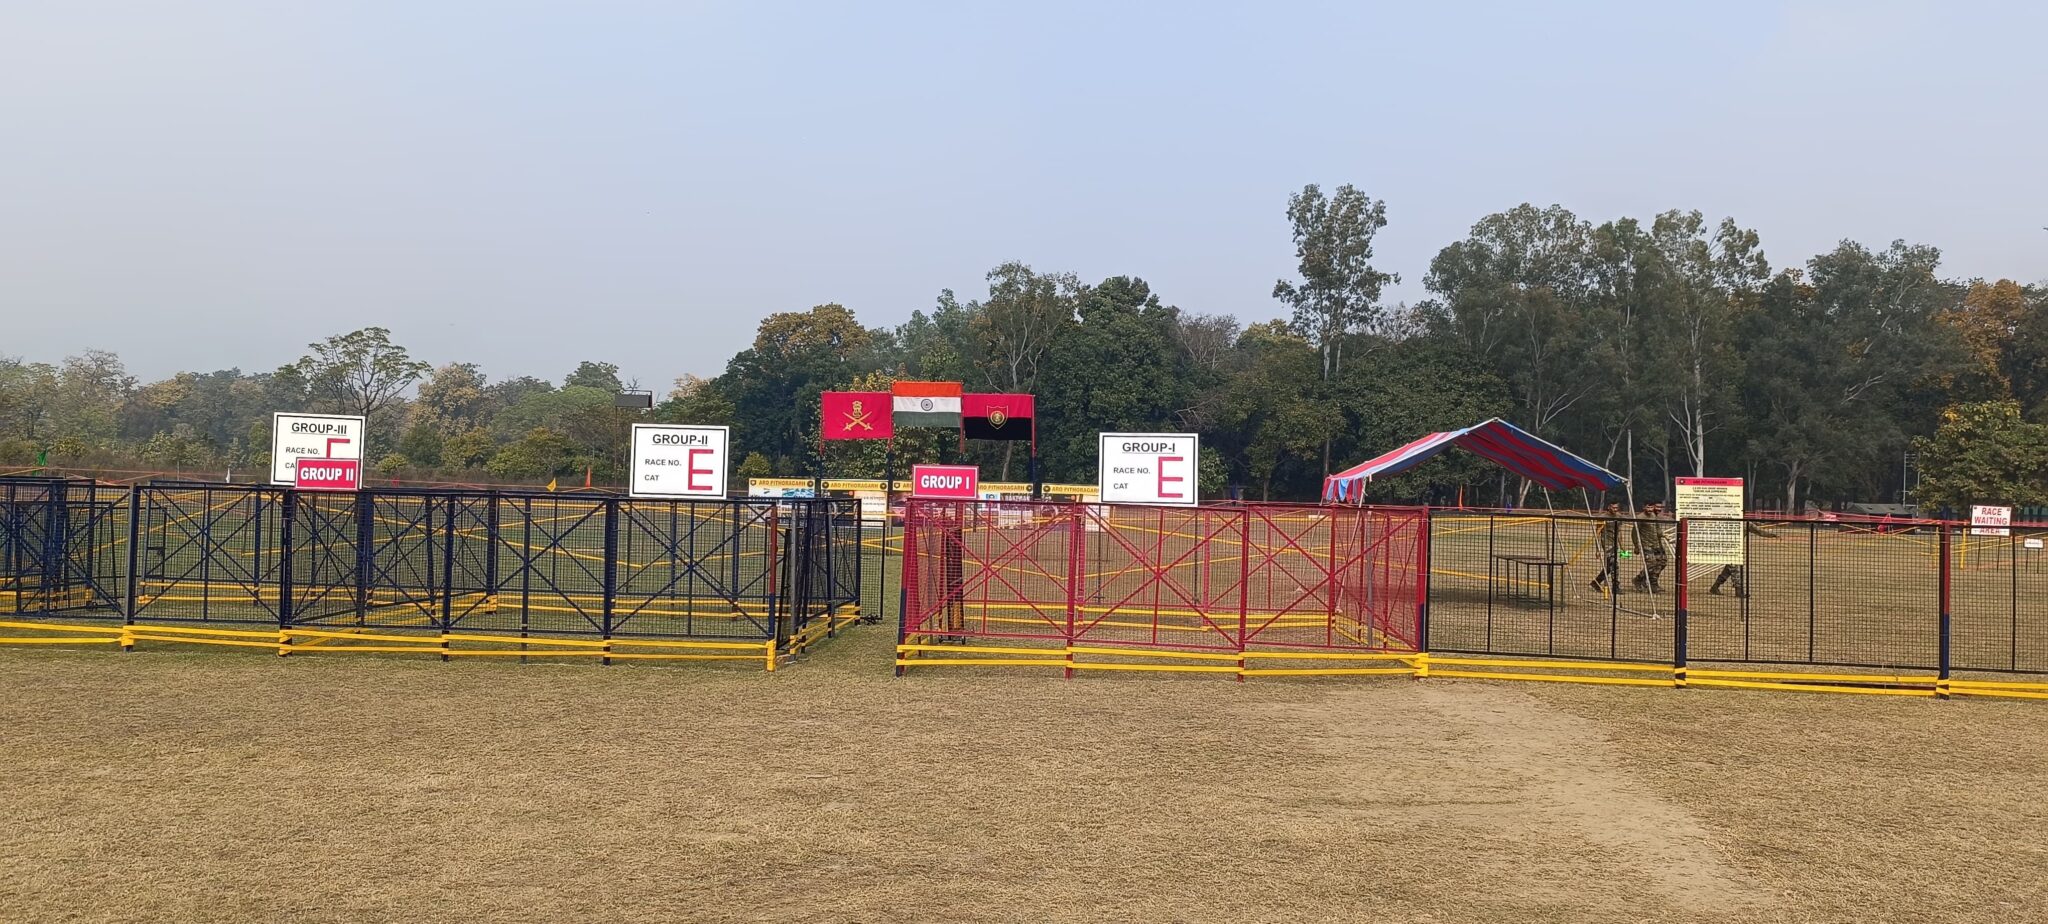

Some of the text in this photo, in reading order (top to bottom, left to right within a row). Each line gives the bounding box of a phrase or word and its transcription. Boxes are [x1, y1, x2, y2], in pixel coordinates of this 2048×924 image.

[291, 422, 347, 434] GROUP-III
[652, 433, 708, 445] GROUP-II
[285, 446, 320, 455] RACE NO.
[1122, 442, 1176, 453] GROUP-I
[644, 458, 666, 466] RACE
[300, 467, 354, 482] GROUP II
[688, 448, 714, 491] E
[1136, 467, 1151, 475] NO.
[921, 474, 970, 490] GROUP I
[1157, 456, 1184, 498] E
[1981, 507, 2003, 516] RACE
[1974, 516, 2008, 525] WAITING
